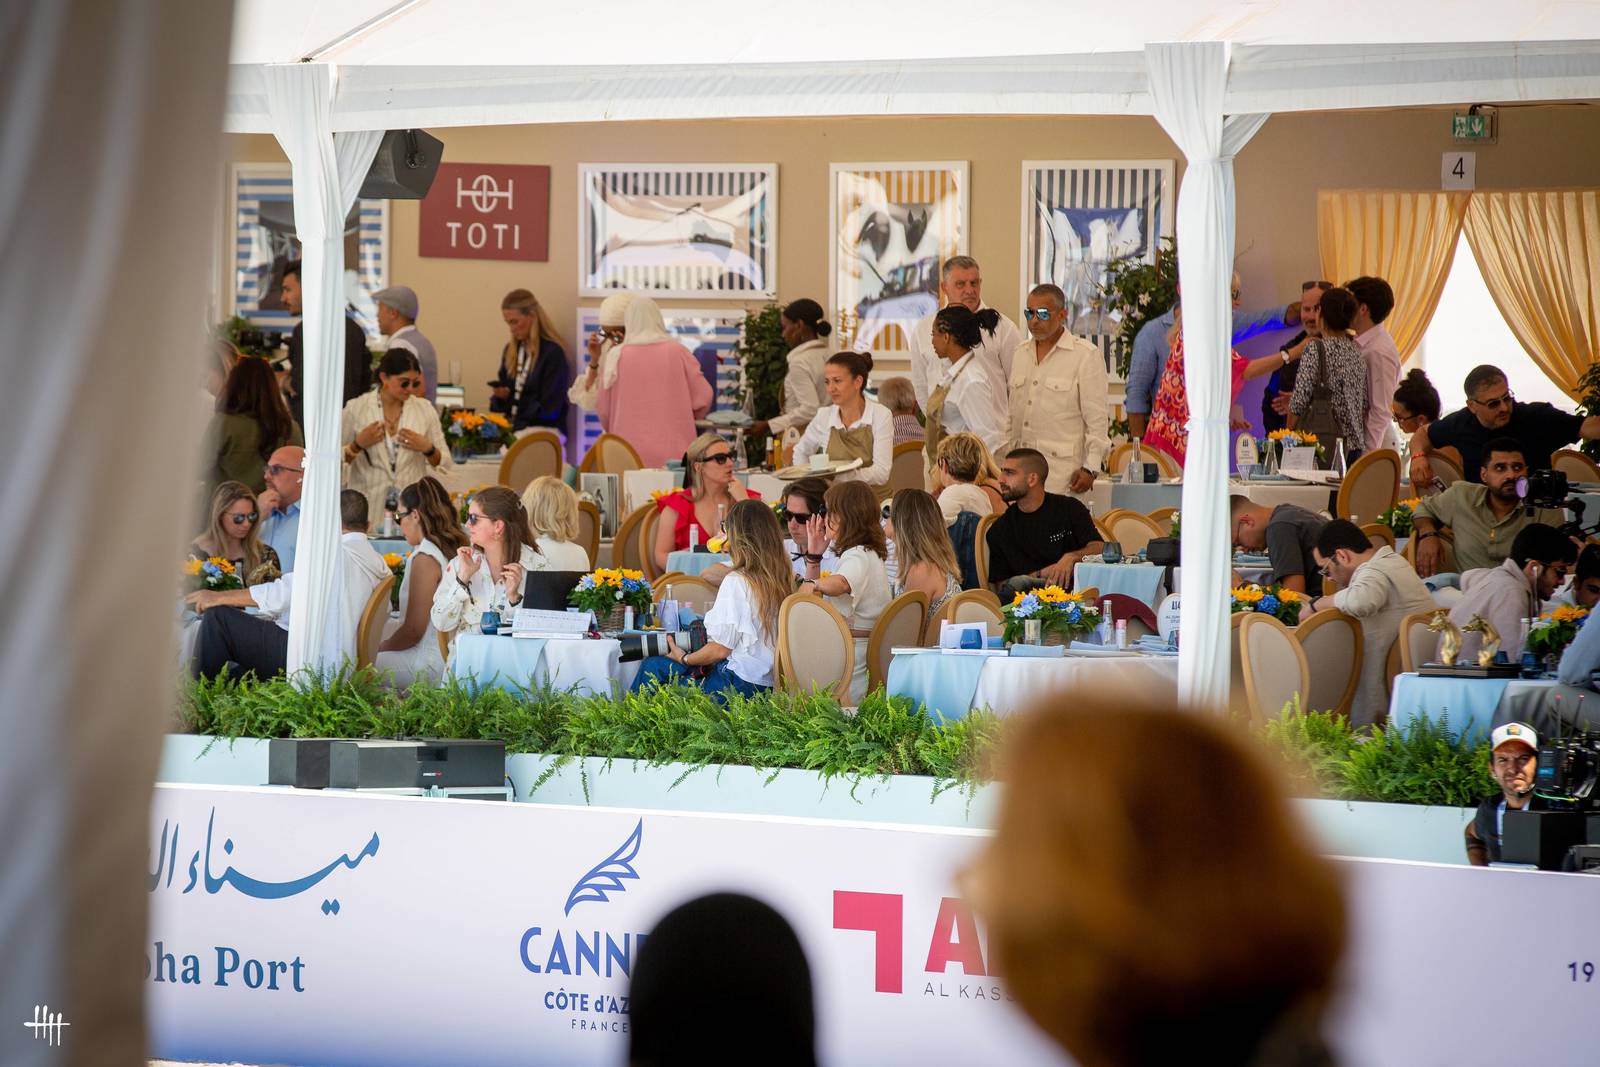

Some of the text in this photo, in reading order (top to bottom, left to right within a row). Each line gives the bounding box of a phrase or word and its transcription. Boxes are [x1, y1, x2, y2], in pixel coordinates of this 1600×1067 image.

[1452, 156, 1465, 180] 4
[446, 221, 520, 250] TOTI
[147, 805, 381, 917] ميناء ال
[144, 941, 306, 993] ha Port
[1568, 961, 1595, 983] 19
[544, 987, 589, 1012] CÔTE
[924, 982, 949, 998] AL
[571, 1018, 628, 1033] FRANCE
